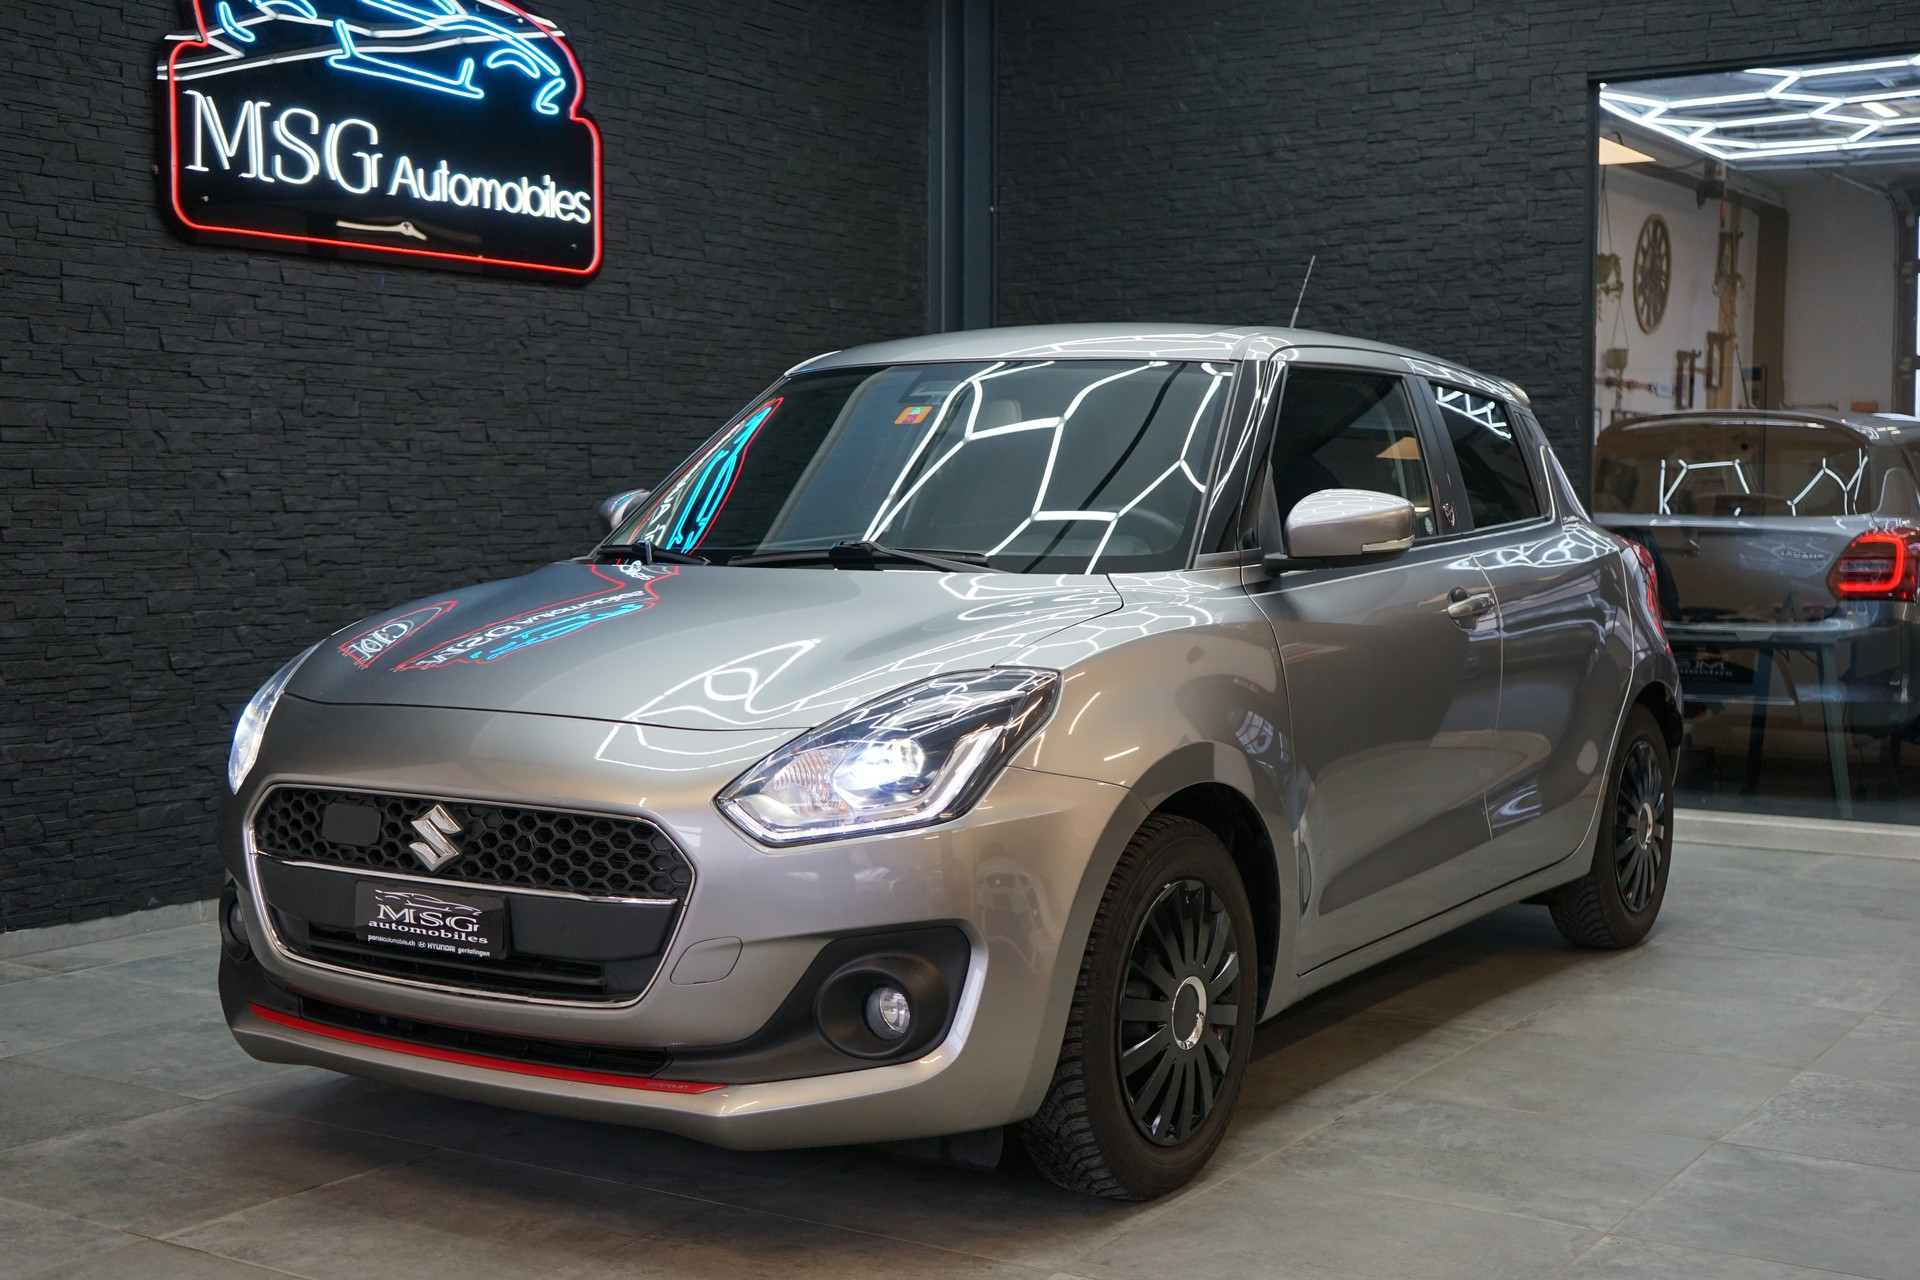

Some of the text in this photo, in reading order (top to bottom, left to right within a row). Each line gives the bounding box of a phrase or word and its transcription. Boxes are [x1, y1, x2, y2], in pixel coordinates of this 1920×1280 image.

[185, 90, 592, 225] MSG Automobiles
[377, 904, 480, 932] MSG
[368, 920, 488, 944] automobiles
[427, 943, 456, 953] HYUNDAI
